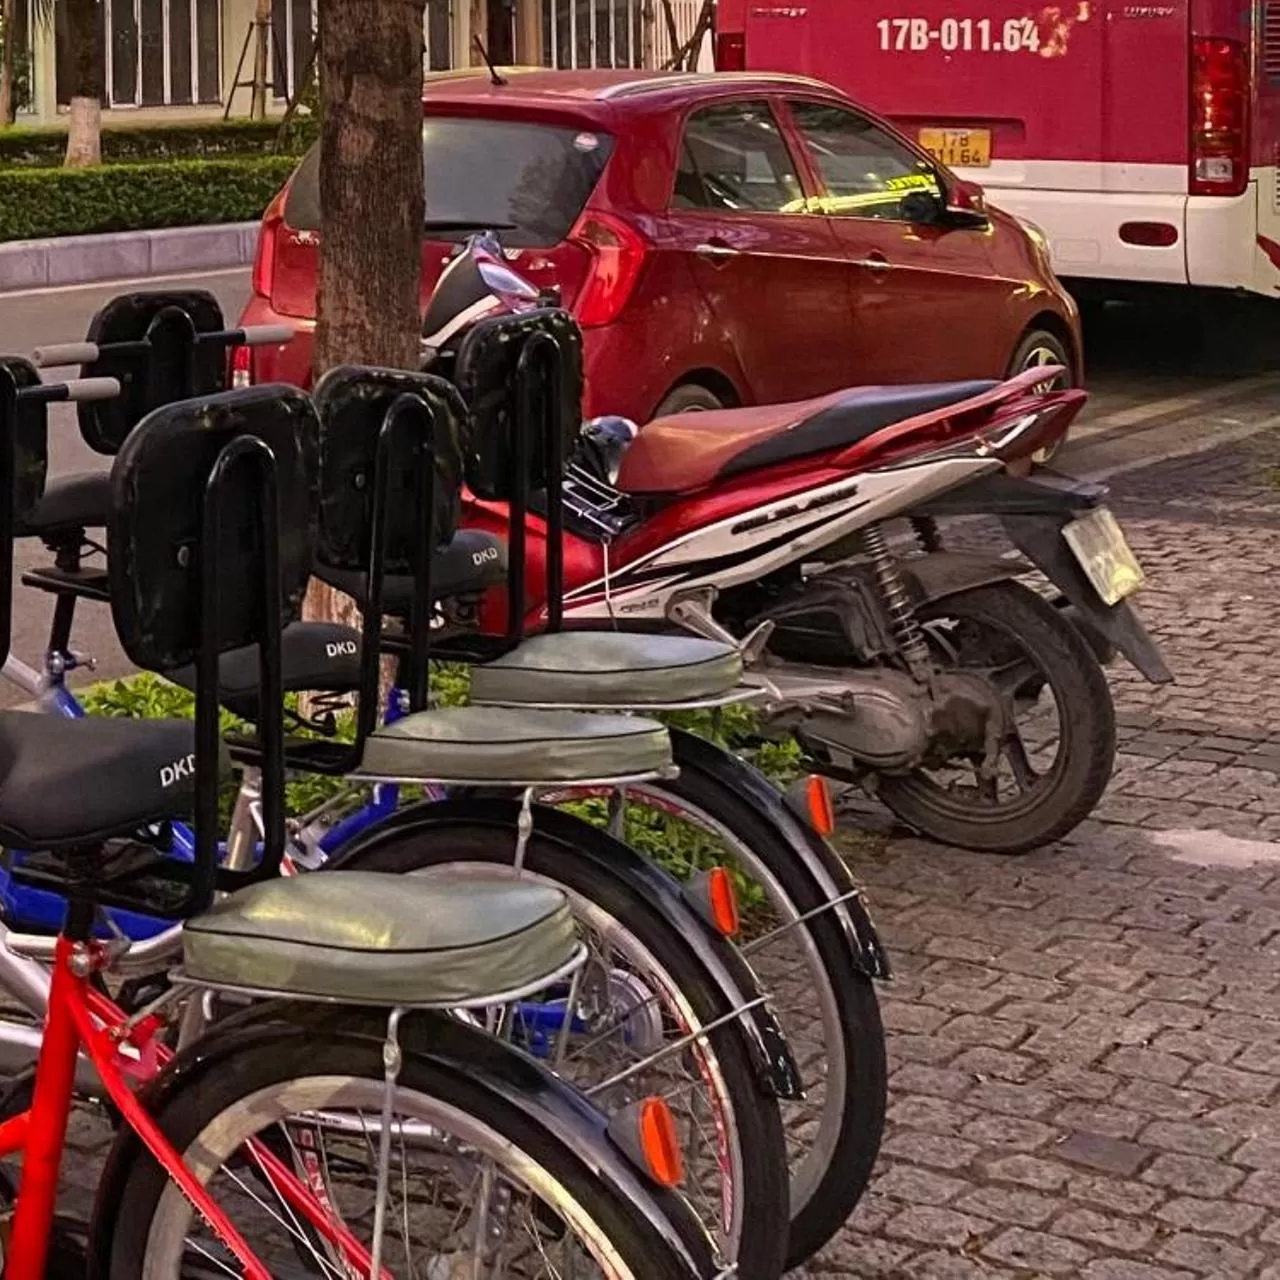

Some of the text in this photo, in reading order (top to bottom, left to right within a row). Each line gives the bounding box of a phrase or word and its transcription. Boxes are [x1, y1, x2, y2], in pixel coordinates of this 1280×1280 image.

[876, 17, 1040, 52] 17B-011.64
[472, 547, 498, 566] DKD
[326, 640, 357, 657] DKD
